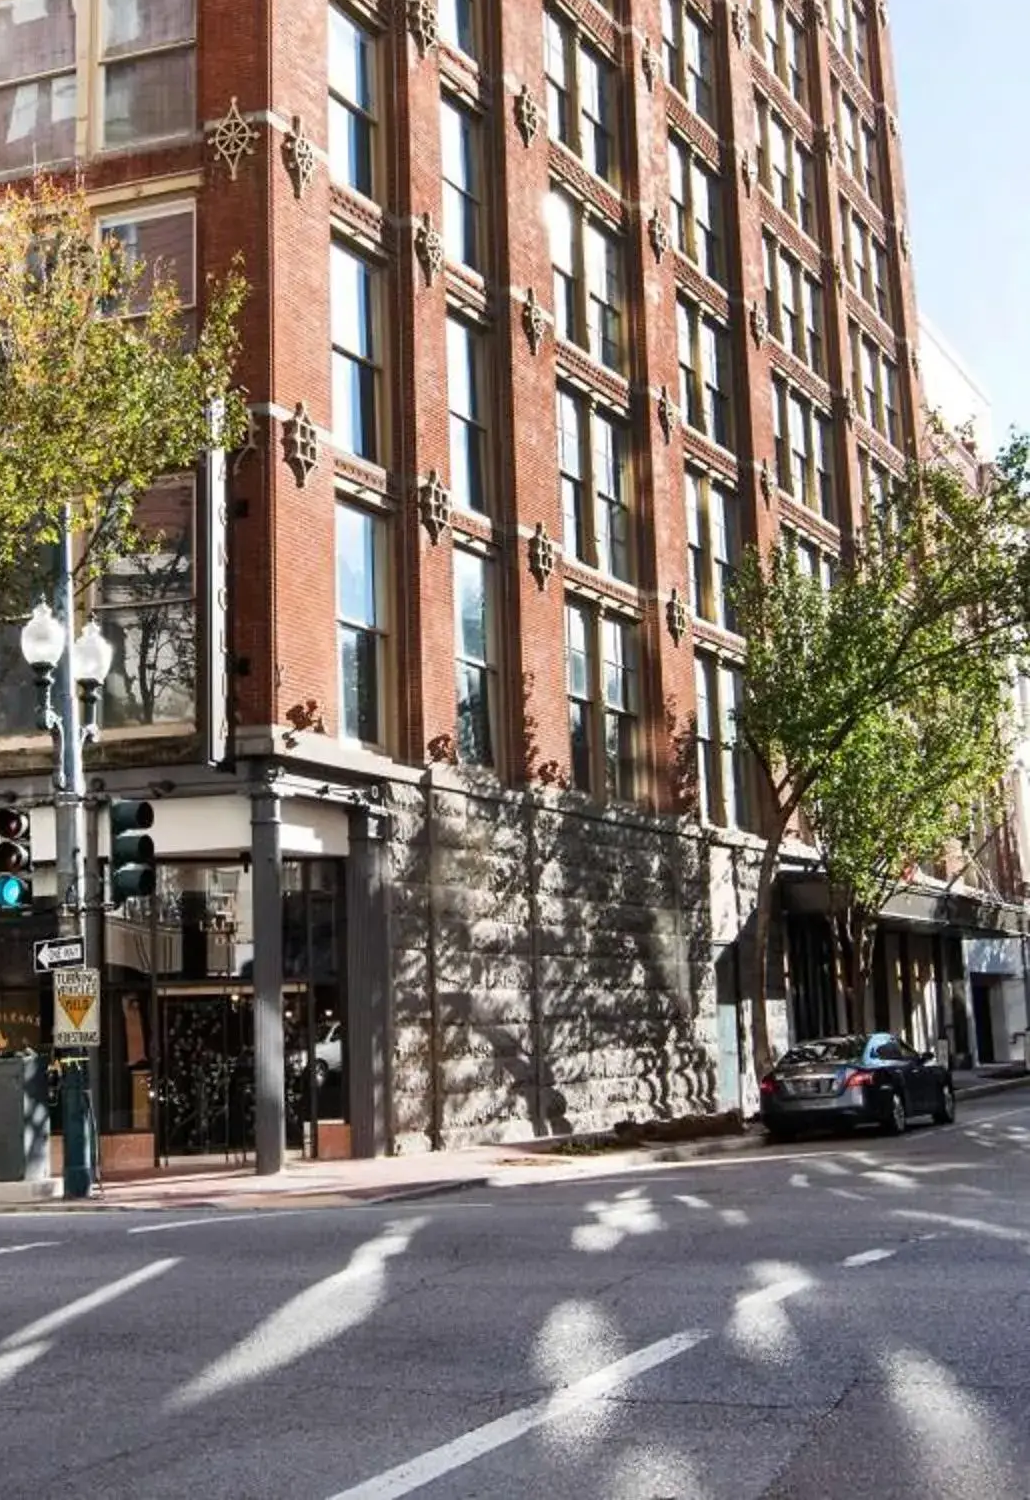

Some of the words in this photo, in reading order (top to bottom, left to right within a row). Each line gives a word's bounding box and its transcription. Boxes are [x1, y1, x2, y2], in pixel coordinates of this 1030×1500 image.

[49, 949, 61, 961] ONE
[63, 947, 79, 958] WAY
[57, 972, 97, 985] TURNING
[65, 999, 90, 1012] YIELD
